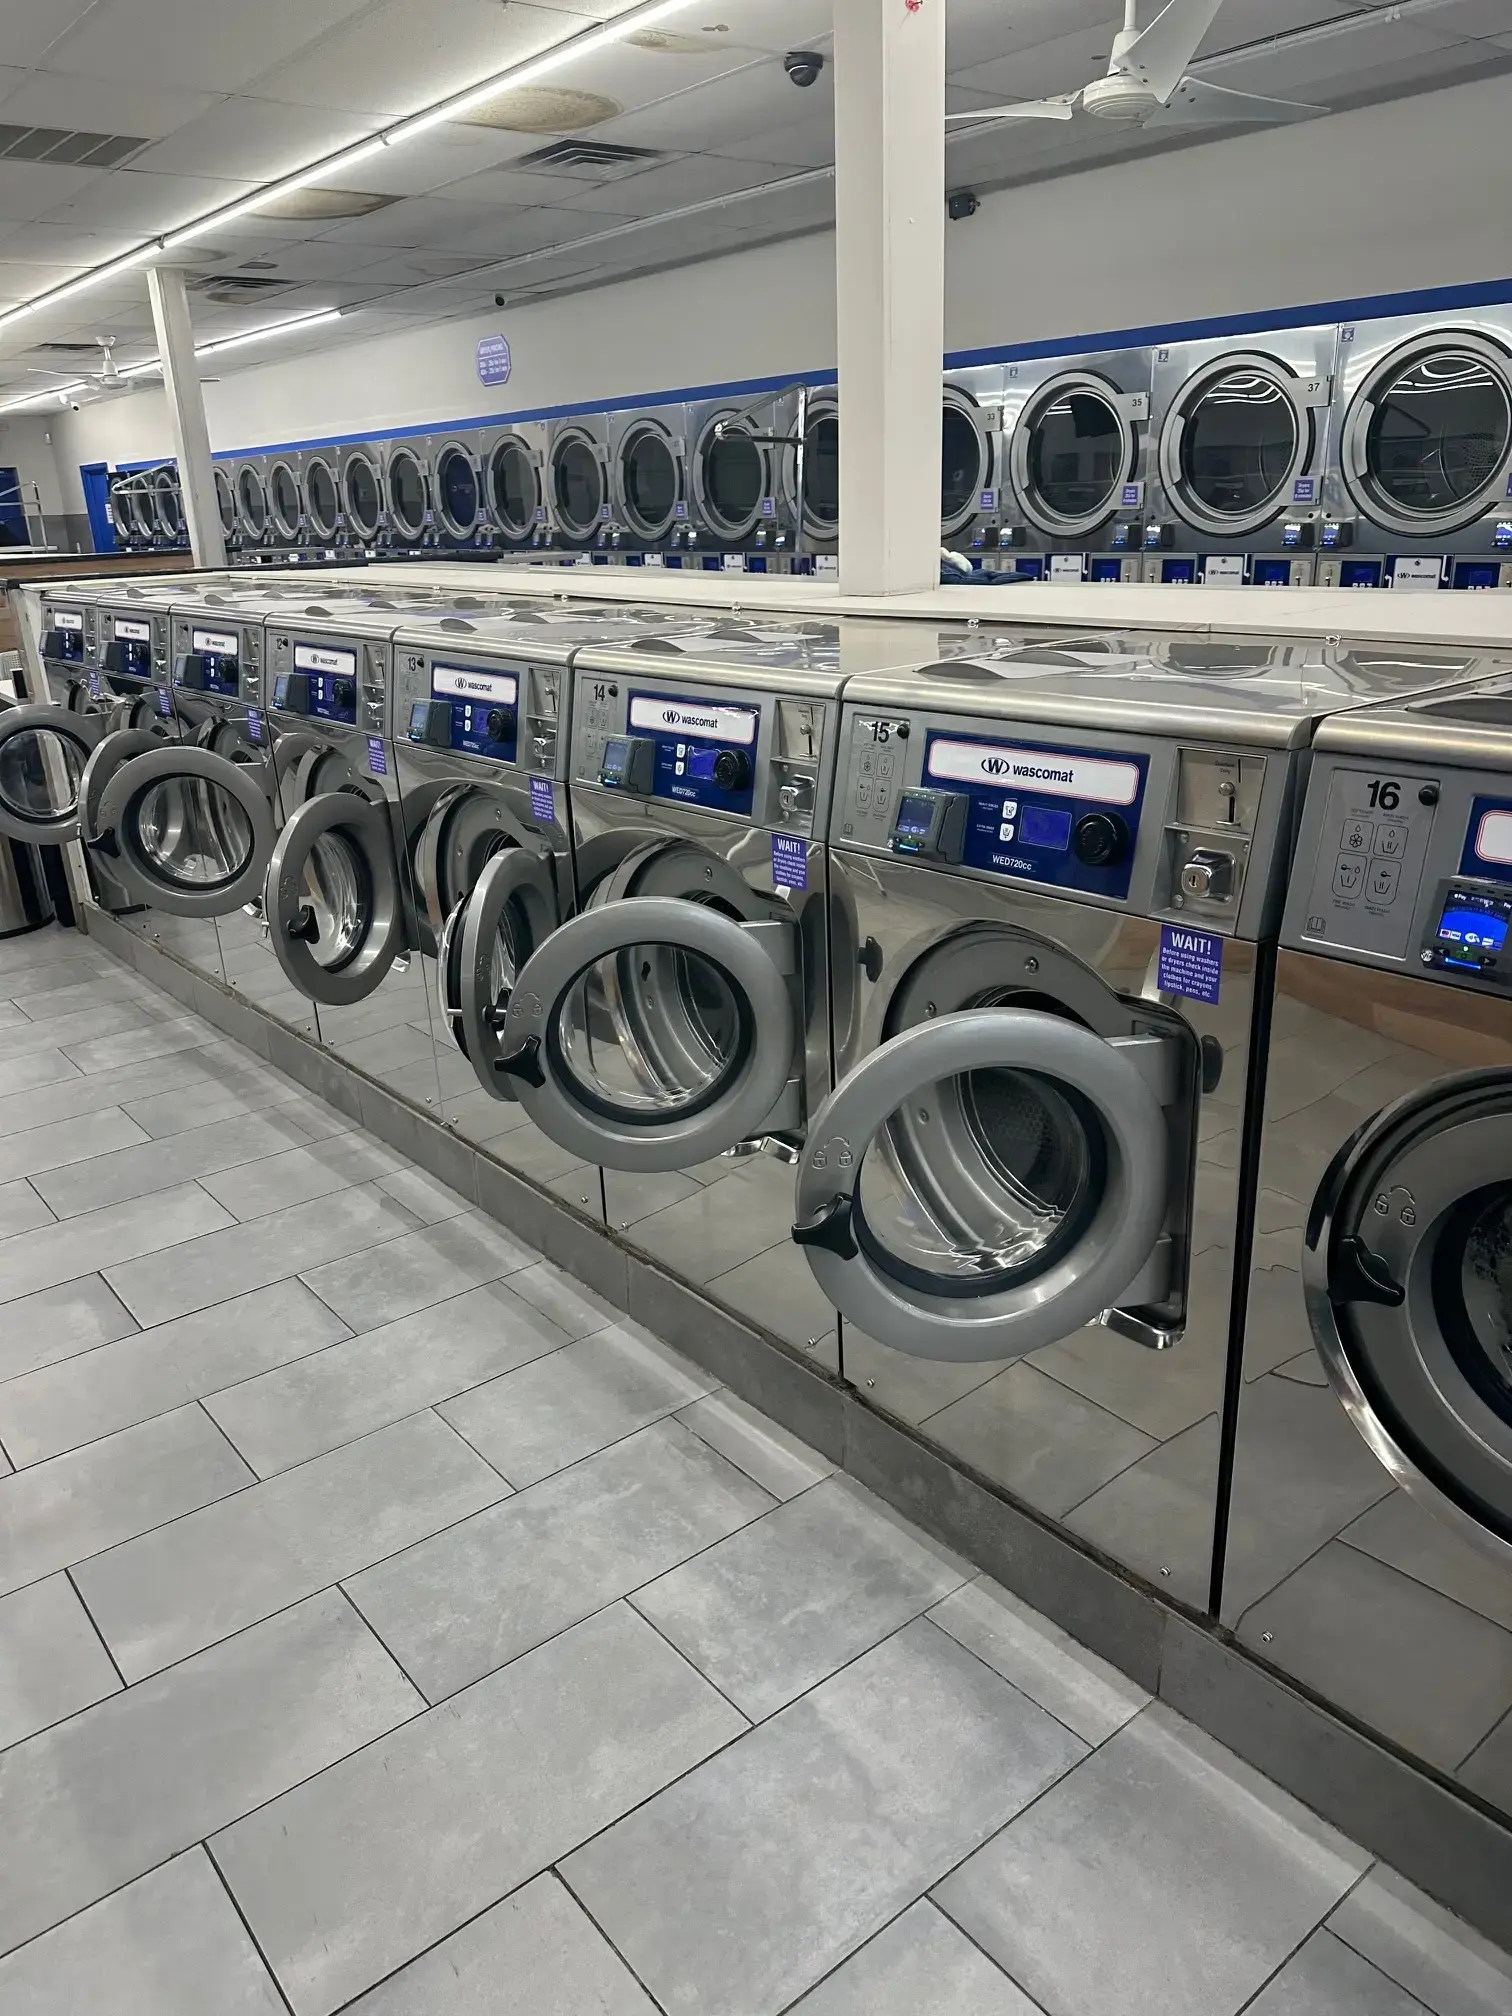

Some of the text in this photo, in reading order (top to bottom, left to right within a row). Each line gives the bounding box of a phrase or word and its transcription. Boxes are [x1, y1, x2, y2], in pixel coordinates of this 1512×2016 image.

[1307, 382, 1320, 392] 37
[1131, 398, 1143, 407] 35
[986, 413, 996, 421] 33
[408, 657, 416, 671] 13
[468, 682, 492, 692] wascomat
[594, 684, 605, 701] 14
[682, 716, 718, 728] wascomat
[872, 721, 890, 743] 15
[1013, 764, 1074, 782] wascomat
[1367, 780, 1401, 810] 16
[777, 838, 801, 854] WAIT!
[992, 854, 1032, 870] WED720cc
[1172, 932, 1211, 955] WAIT!
[1163, 947, 1219, 966] Before using washers
[1169, 957, 1184, 966] dryers
[1186, 962, 1201, 970] check
[1202, 965, 1218, 975] inside
[1163, 973, 1182, 982] clothes
[1171, 967, 1193, 977] machine
[1205, 975, 1218, 983] your
